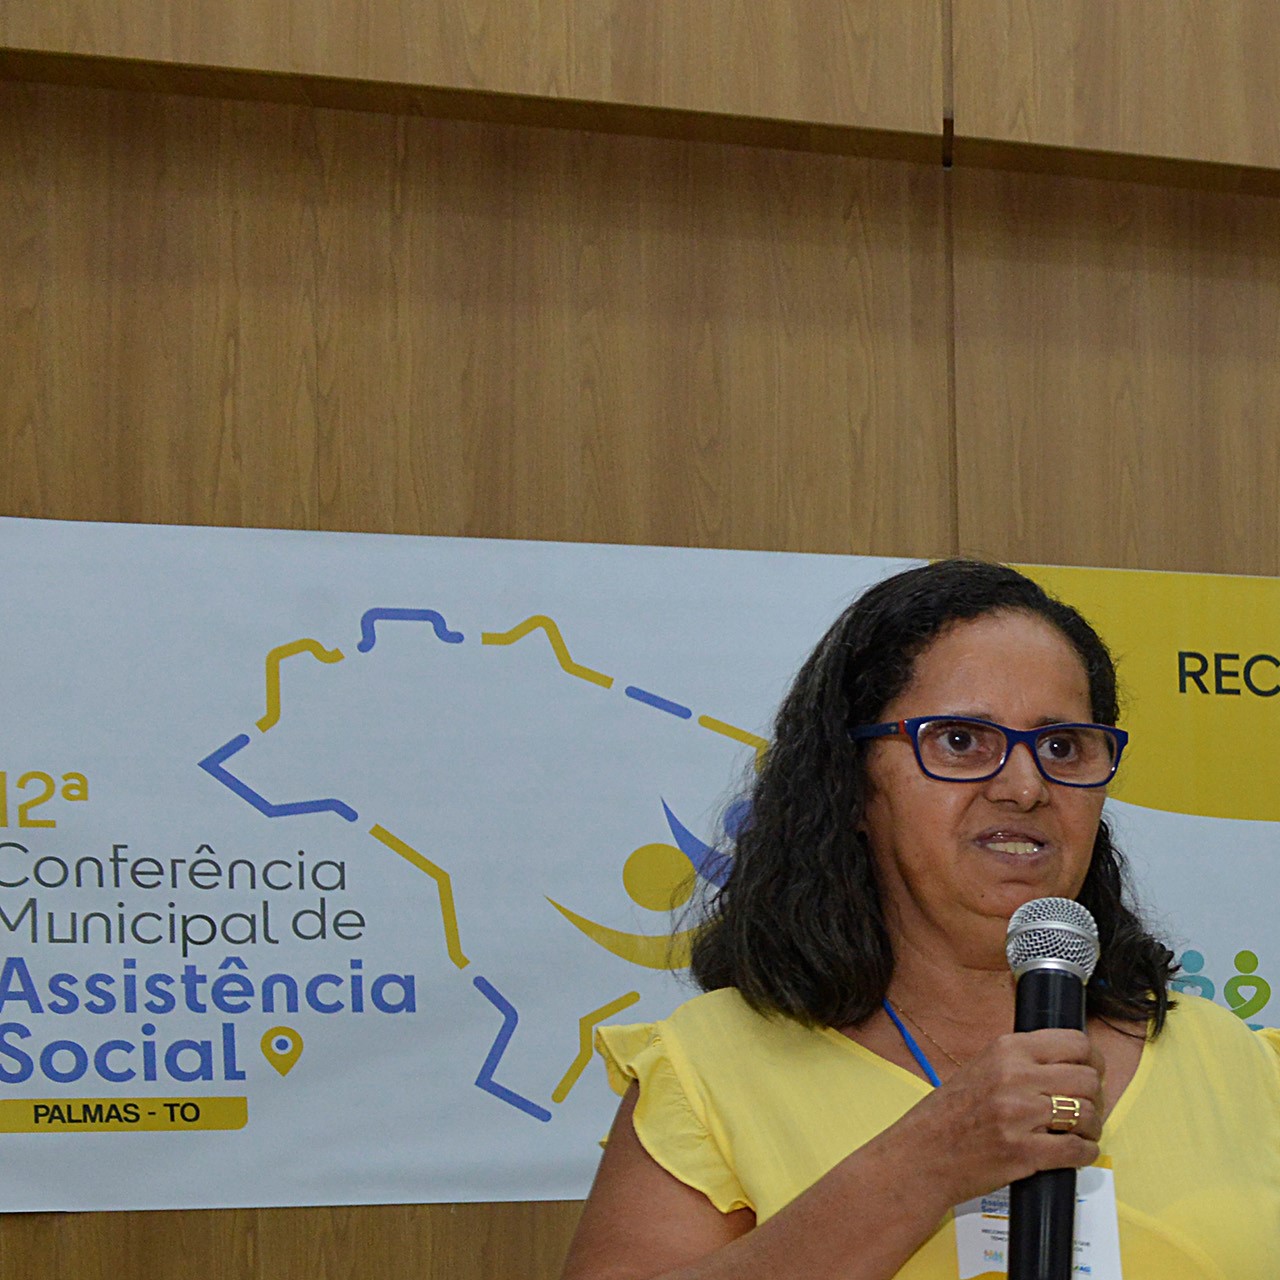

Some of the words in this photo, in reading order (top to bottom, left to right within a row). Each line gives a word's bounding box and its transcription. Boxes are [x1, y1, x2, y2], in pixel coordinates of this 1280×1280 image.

[291, 897, 366, 940] de
[0, 955, 417, 1015] Assistência
[0, 1021, 247, 1084] Social
[33, 1103, 140, 1124] PALMAS
[163, 1102, 201, 1122] TO
